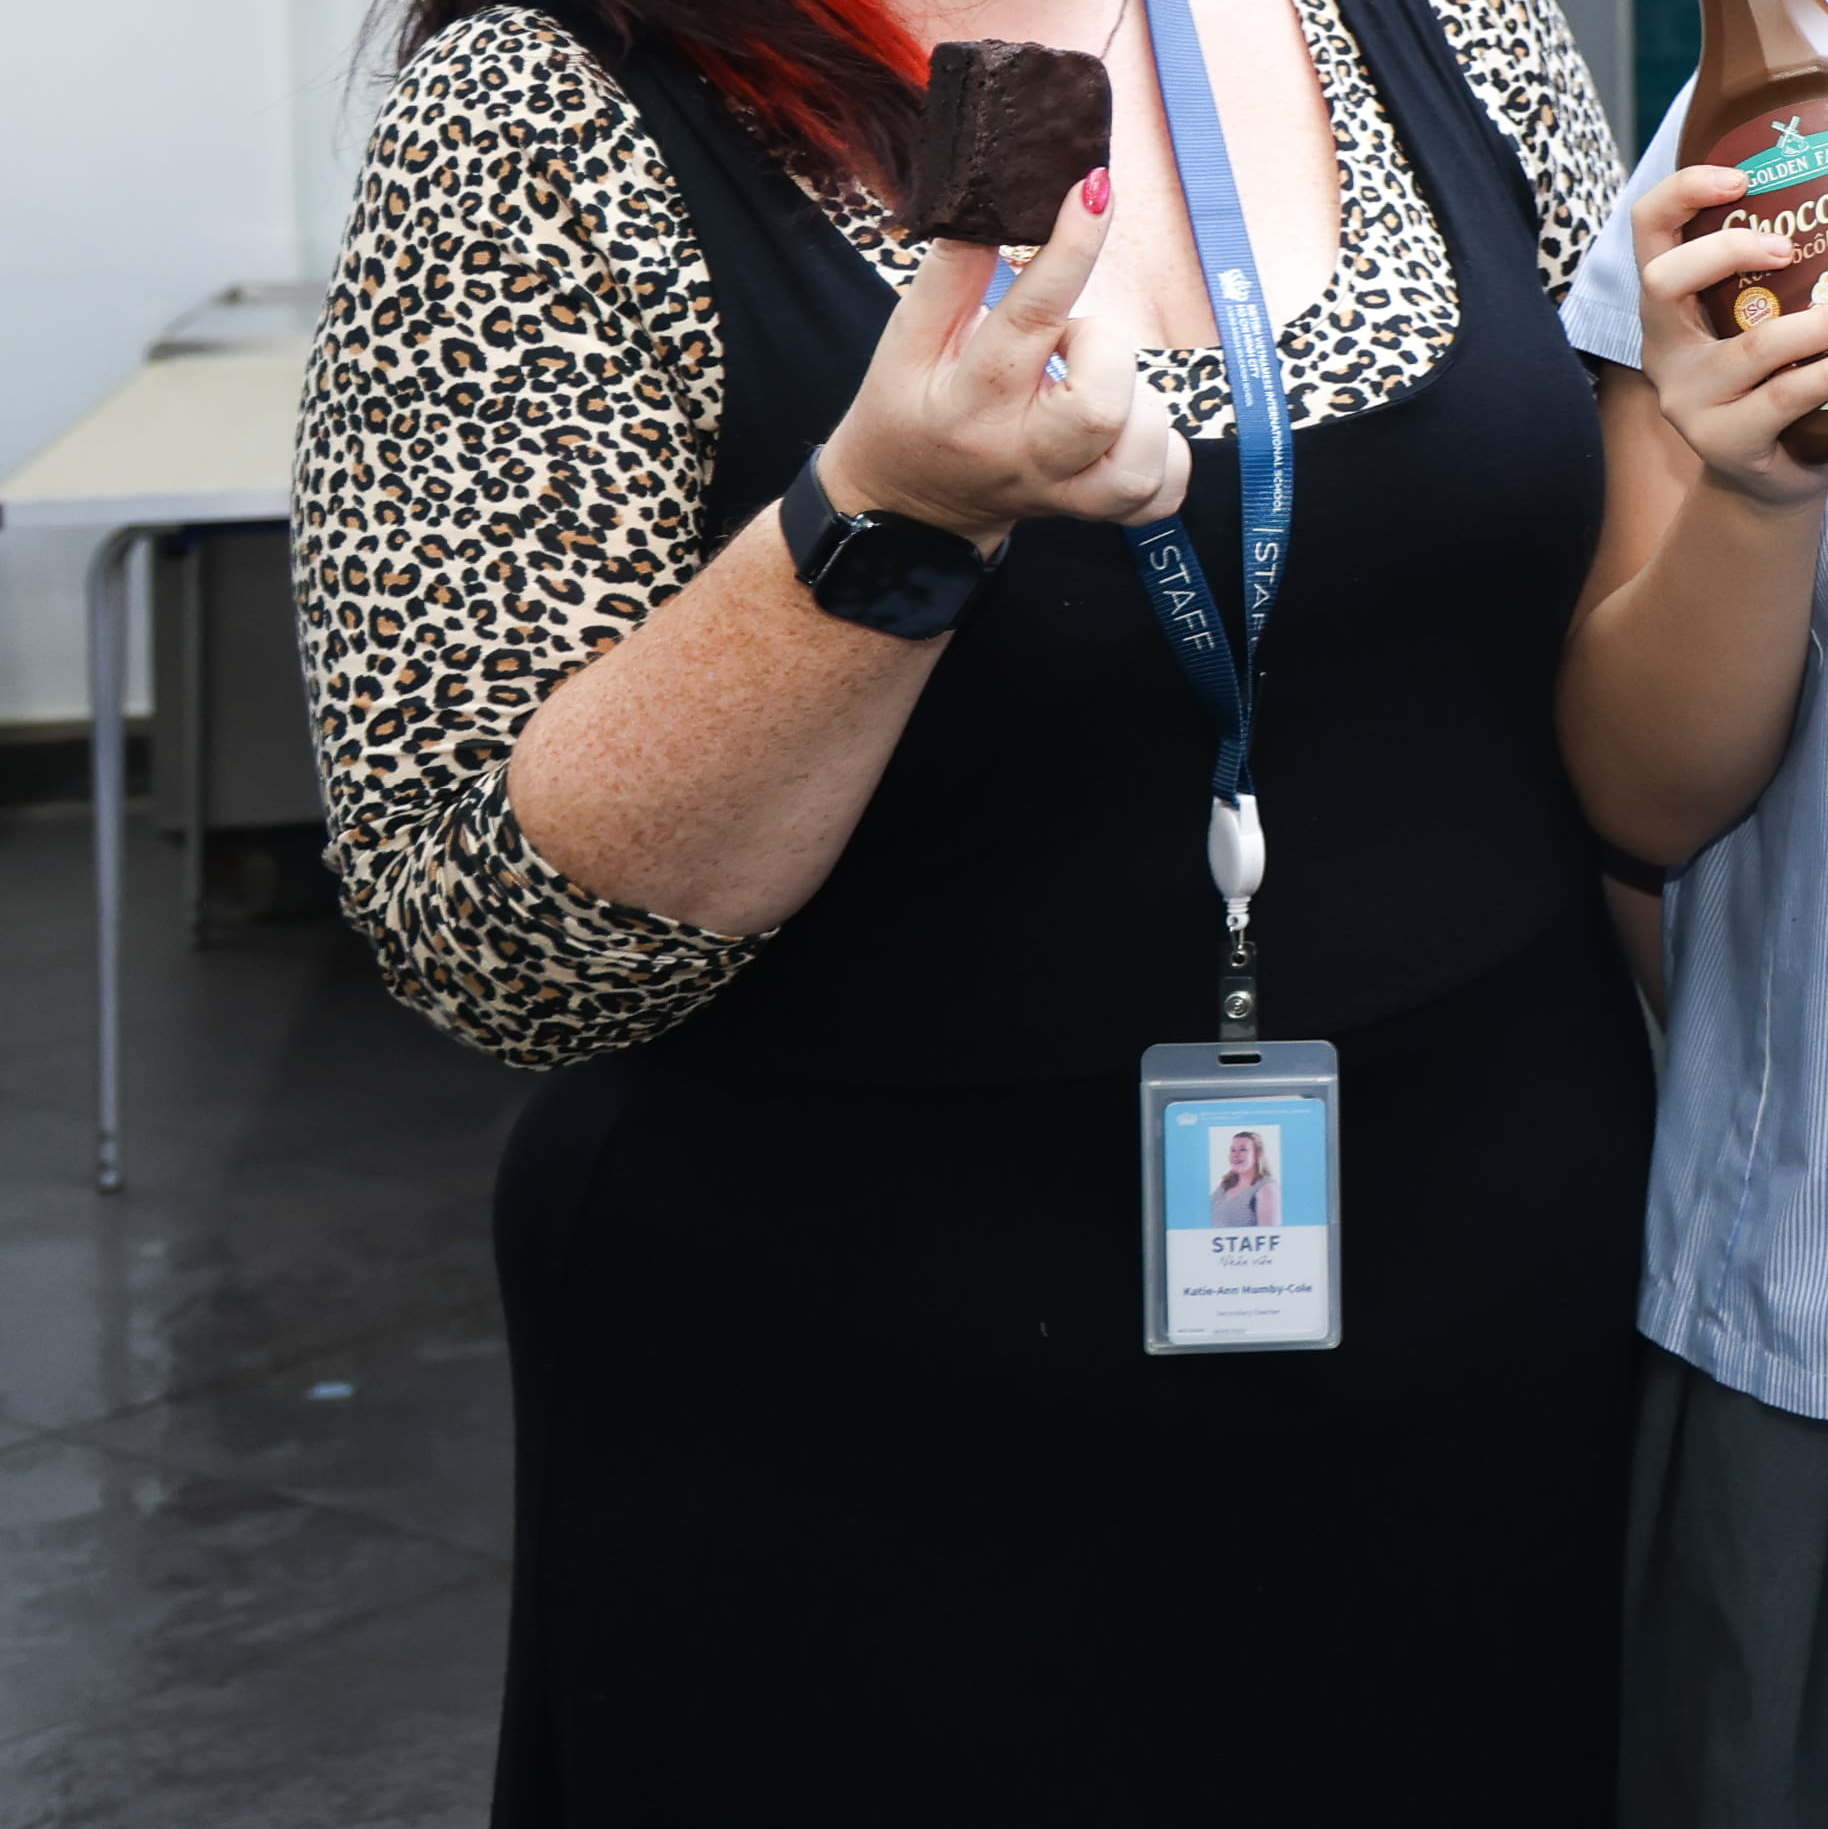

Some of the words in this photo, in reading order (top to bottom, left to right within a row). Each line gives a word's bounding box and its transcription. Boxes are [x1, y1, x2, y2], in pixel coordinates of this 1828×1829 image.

[1746, 156, 1809, 187] GOLDEN
[1743, 298, 1768, 320] ISO
[1243, 333, 1256, 357] MINH
[1254, 335, 1275, 390] VIETNAMESE
[1247, 358, 1260, 379] CITY
[1264, 392, 1284, 468] INTERNATIONAL
[1272, 470, 1283, 513] SCHOOL
[1150, 545, 1214, 650] STAFF
[1250, 542, 1279, 642] STAF
[1212, 1235, 1280, 1253] STAFF
